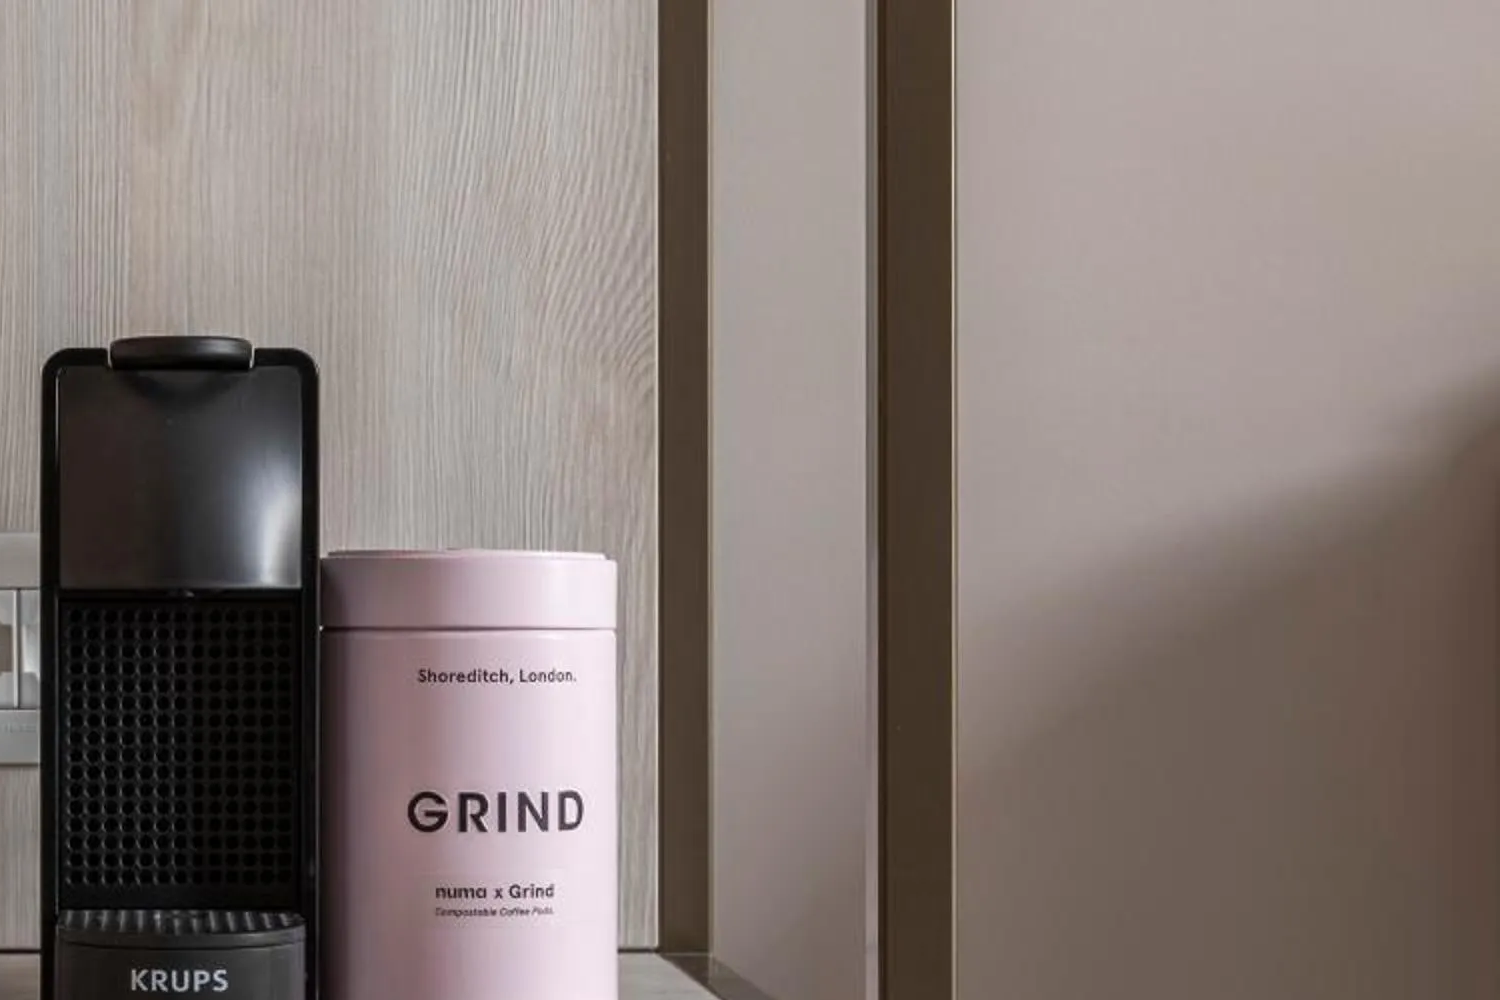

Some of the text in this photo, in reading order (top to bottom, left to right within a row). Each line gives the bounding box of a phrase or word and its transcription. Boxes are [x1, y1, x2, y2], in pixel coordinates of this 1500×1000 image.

[417, 668, 577, 684] Shoreditch, London.
[407, 790, 584, 833] GRIND
[435, 883, 555, 899] numa x Grind
[131, 969, 229, 992] KRUPS
